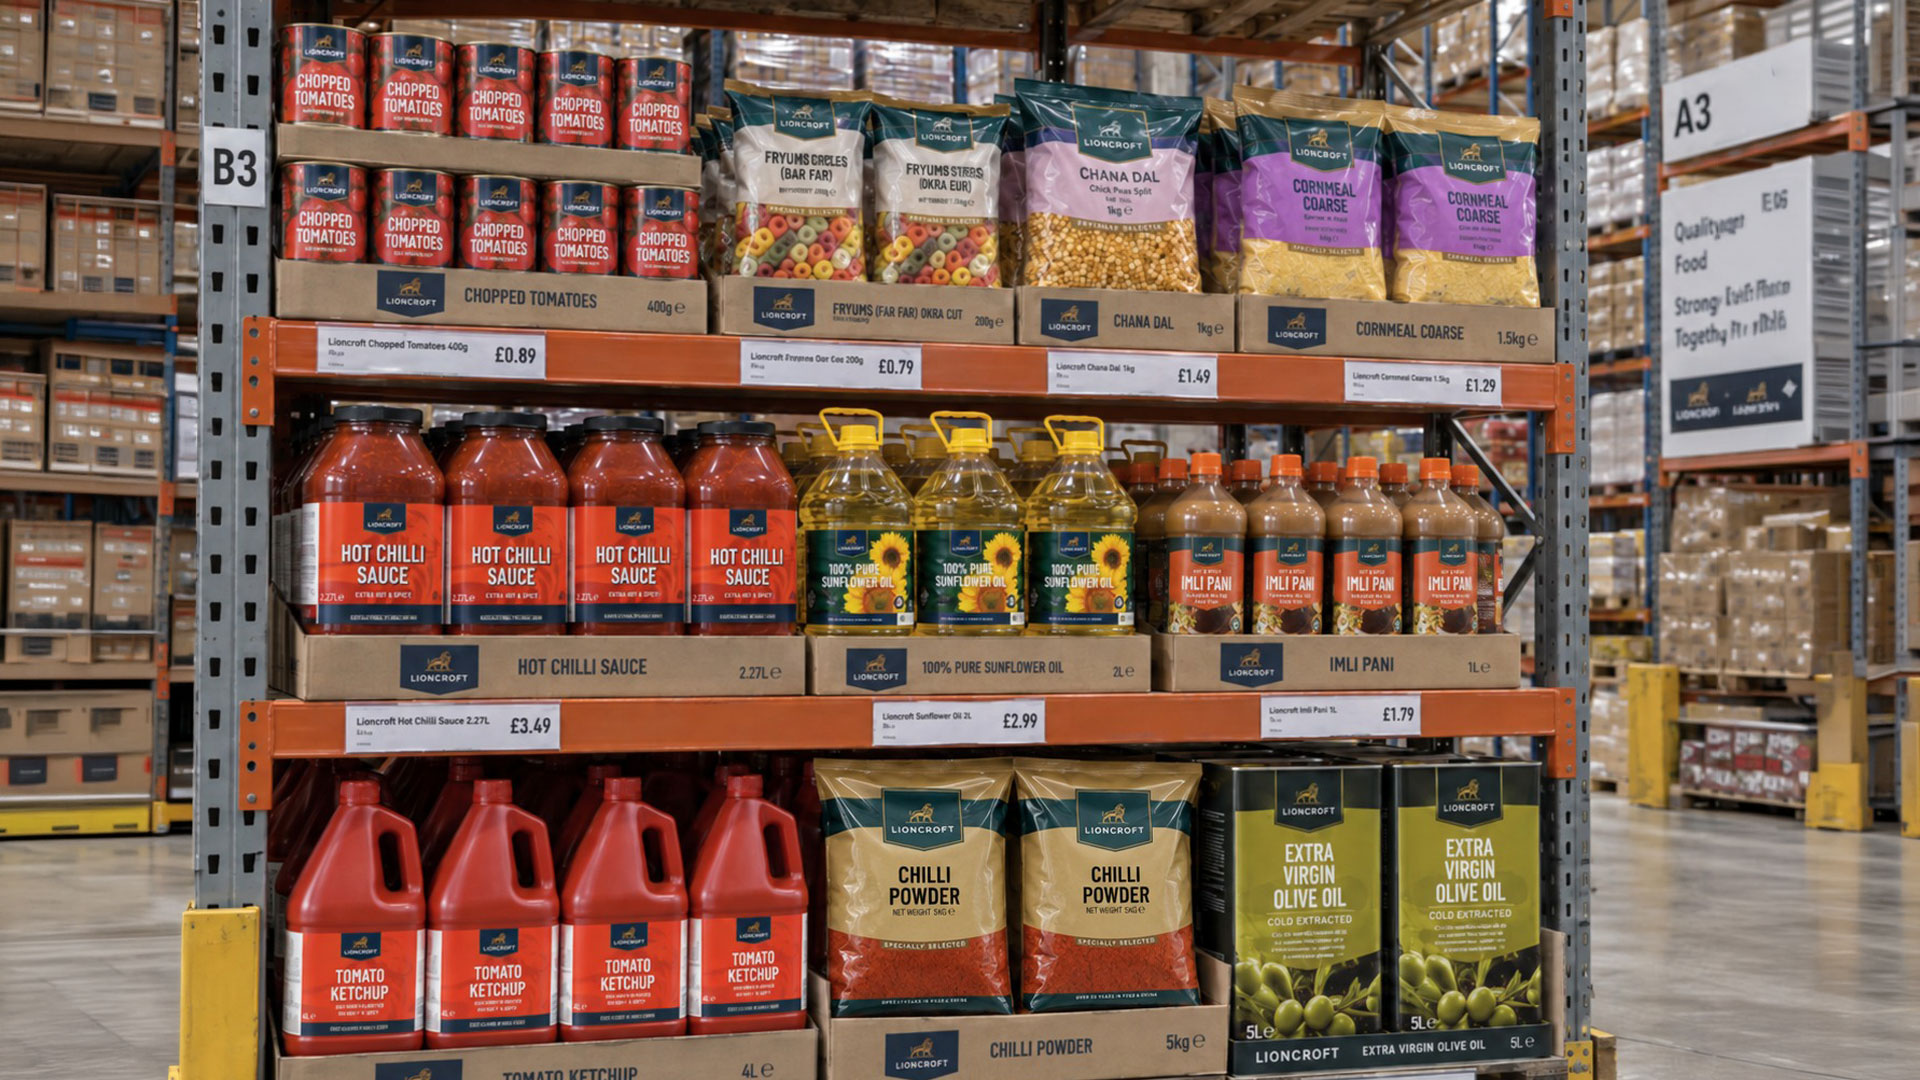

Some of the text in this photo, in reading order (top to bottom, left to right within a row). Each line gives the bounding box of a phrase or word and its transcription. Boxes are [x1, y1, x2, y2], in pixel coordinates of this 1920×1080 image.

[297, 73, 352, 92] CHOPPED
[386, 82, 440, 101] CHOPPED
[295, 88, 355, 111] TOMATOES
[384, 97, 443, 118] TOMATOES
[632, 102, 680, 120] CHOPPED
[1674, 93, 1712, 138] A3
[629, 118, 683, 136] TOMATOES
[1084, 139, 1143, 151] LIONCROFT
[764, 151, 810, 166] FRYUMS
[213, 148, 257, 188] B3
[906, 163, 950, 177] FRYUMS
[1079, 166, 1160, 184] CHANA DAL
[1293, 178, 1357, 198] CORNMEAL
[1302, 196, 1348, 213] COARSE
[1447, 191, 1510, 210] CORNMEAL
[300, 211, 353, 229] CHOPPED
[388, 216, 440, 234] CHOPPED
[1456, 208, 1501, 224] COARSE
[296, 228, 356, 248] TOMATOES
[384, 232, 444, 251] TOMATOES
[639, 232, 688, 248] CHOPPED
[636, 247, 690, 264] TOMATOES
[1676, 251, 1708, 275] Food
[386, 297, 437, 307] LIONCROFT
[464, 287, 673, 317] CHOPPED TOMATOES 400g
[833, 302, 994, 329] FRYUMS (FAR FAR) OKRA CUT 200g
[1048, 323, 1092, 332] LIONCROFT
[1114, 314, 1213, 337] CHANA DAL 1kg
[1356, 320, 1526, 348] CORNMEAL COARSE 1.5kg
[328, 337, 537, 364] Lioncroft Chopped Tomatoes 400g £0.89
[750, 352, 784, 362] Lioncroft
[845, 356, 864, 366] 200g
[878, 359, 914, 376] £0.79
[1087, 364, 1108, 372] Chana
[1108, 364, 1121, 372] Dal
[1178, 368, 1211, 384] £1.49
[1466, 378, 1497, 394] £1.29
[341, 544, 425, 563] HOT CHILLI
[472, 546, 551, 564] HOT CHILLI
[596, 546, 672, 564] HOT CHILLI
[710, 548, 784, 566] HOT CHILLI
[357, 566, 409, 585] SAUCE
[488, 568, 536, 586] SAUCE
[611, 567, 657, 584] SAUCE
[726, 568, 770, 586] SAUCE
[829, 562, 854, 575] 100%
[943, 562, 968, 575] 100%
[1051, 564, 1075, 576] 100%
[1100, 576, 1114, 588] OIL
[1181, 576, 1232, 591] IMLI PANI
[1265, 576, 1316, 591] IMLI PANI
[1346, 576, 1396, 592] IMLI PANI
[1428, 576, 1450, 592] IMLI
[518, 658, 768, 680] HOT CHILLI SAUCE 2.27L
[922, 660, 1065, 674] 100% PURE SUNFLOWER OIL
[1228, 668, 1276, 678] LIONCROFT
[1330, 656, 1395, 673] IMLI PANI
[410, 674, 469, 682] LIONCROFT
[853, 673, 900, 682] LIONCROFT
[882, 712, 914, 722] Lioncroft
[916, 712, 952, 721] Sunflower
[1003, 713, 1038, 730] £2.99
[1269, 706, 1298, 716] Lioncroft
[1314, 706, 1329, 714] Pani
[1382, 706, 1415, 722] £1.79
[357, 716, 551, 735] Lioncroft Hot Chilli Sauce 2.27L £3.49
[1282, 806, 1336, 816] LIONCROFT
[1444, 803, 1496, 812] LIONCROFT
[892, 826, 954, 834] LIONCROFT
[1084, 826, 1144, 835] LIONCROFT
[1285, 842, 1335, 864] EXTRA
[1446, 838, 1494, 858] EXTRA
[898, 866, 951, 884] CHILLI
[1091, 866, 1141, 883] CHILLI
[1283, 864, 1336, 886] VIRGIN
[1444, 859, 1496, 880] VIRGIN
[889, 887, 960, 906] POWDER
[1083, 886, 1150, 904] POWDER
[1273, 887, 1348, 910] OLIVE OIL
[1436, 882, 1507, 904] OLIVE OIL
[892, 908, 932, 916] NET WEIGHT
[1086, 906, 1098, 914] NET
[1428, 908, 1513, 920] COLD EXTRACTED
[1267, 915, 1354, 927] COLD EXTRACTED
[606, 958, 652, 974] TOMATO
[732, 950, 776, 966] TOMATO
[336, 968, 385, 984] TOMATO
[474, 964, 522, 981] TOMATO
[728, 966, 780, 984] KETCHUP
[470, 982, 526, 998] KETCHUP
[600, 975, 656, 992] KETCHUP
[330, 986, 389, 1002] KETCHUP
[990, 1033, 1190, 1058] CHILLI POWDER 5kg
[1256, 1036, 1523, 1064] LIONCROFT EXTRA VIRGIN OLIVE OIL 5L
[742, 1064, 758, 1078] 4L
[896, 1058, 949, 1072] LIONCROFT
